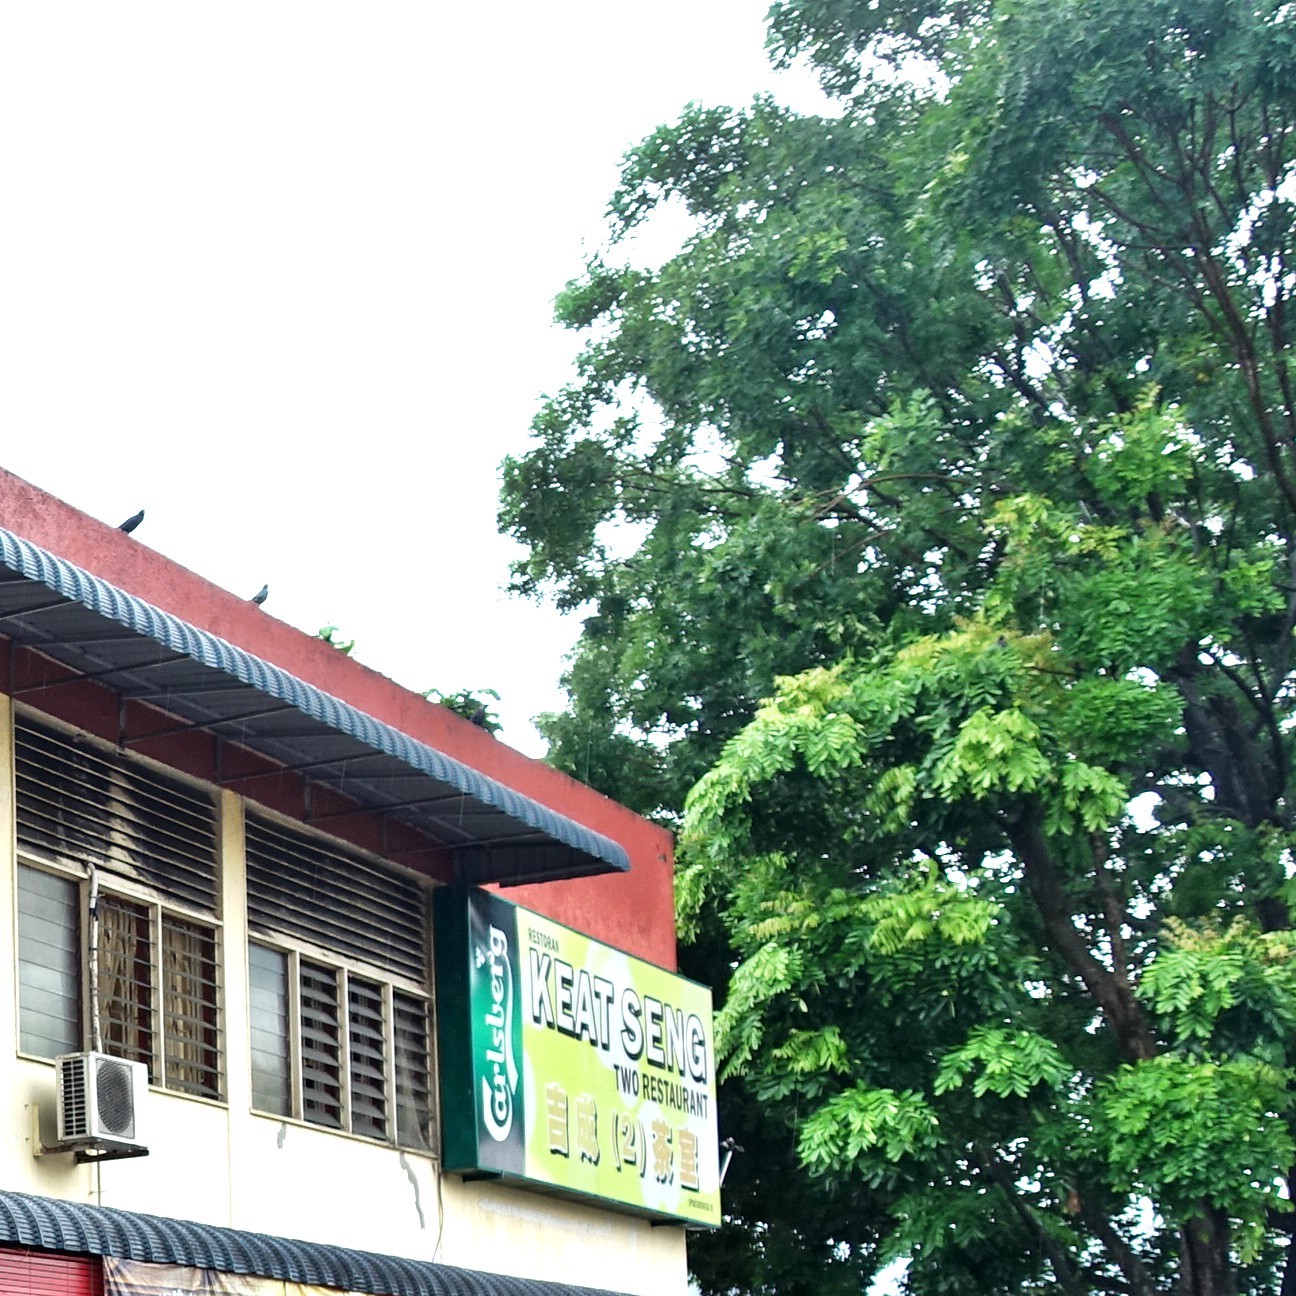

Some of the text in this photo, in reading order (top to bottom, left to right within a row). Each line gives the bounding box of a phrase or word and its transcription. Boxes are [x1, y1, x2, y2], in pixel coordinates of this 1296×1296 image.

[527, 927, 560, 953] RESTORAN
[483, 923, 518, 1141] Carlsberg
[529, 948, 708, 1085] KEAT SENG
[613, 1063, 708, 1119] TWO RESTAURANT
